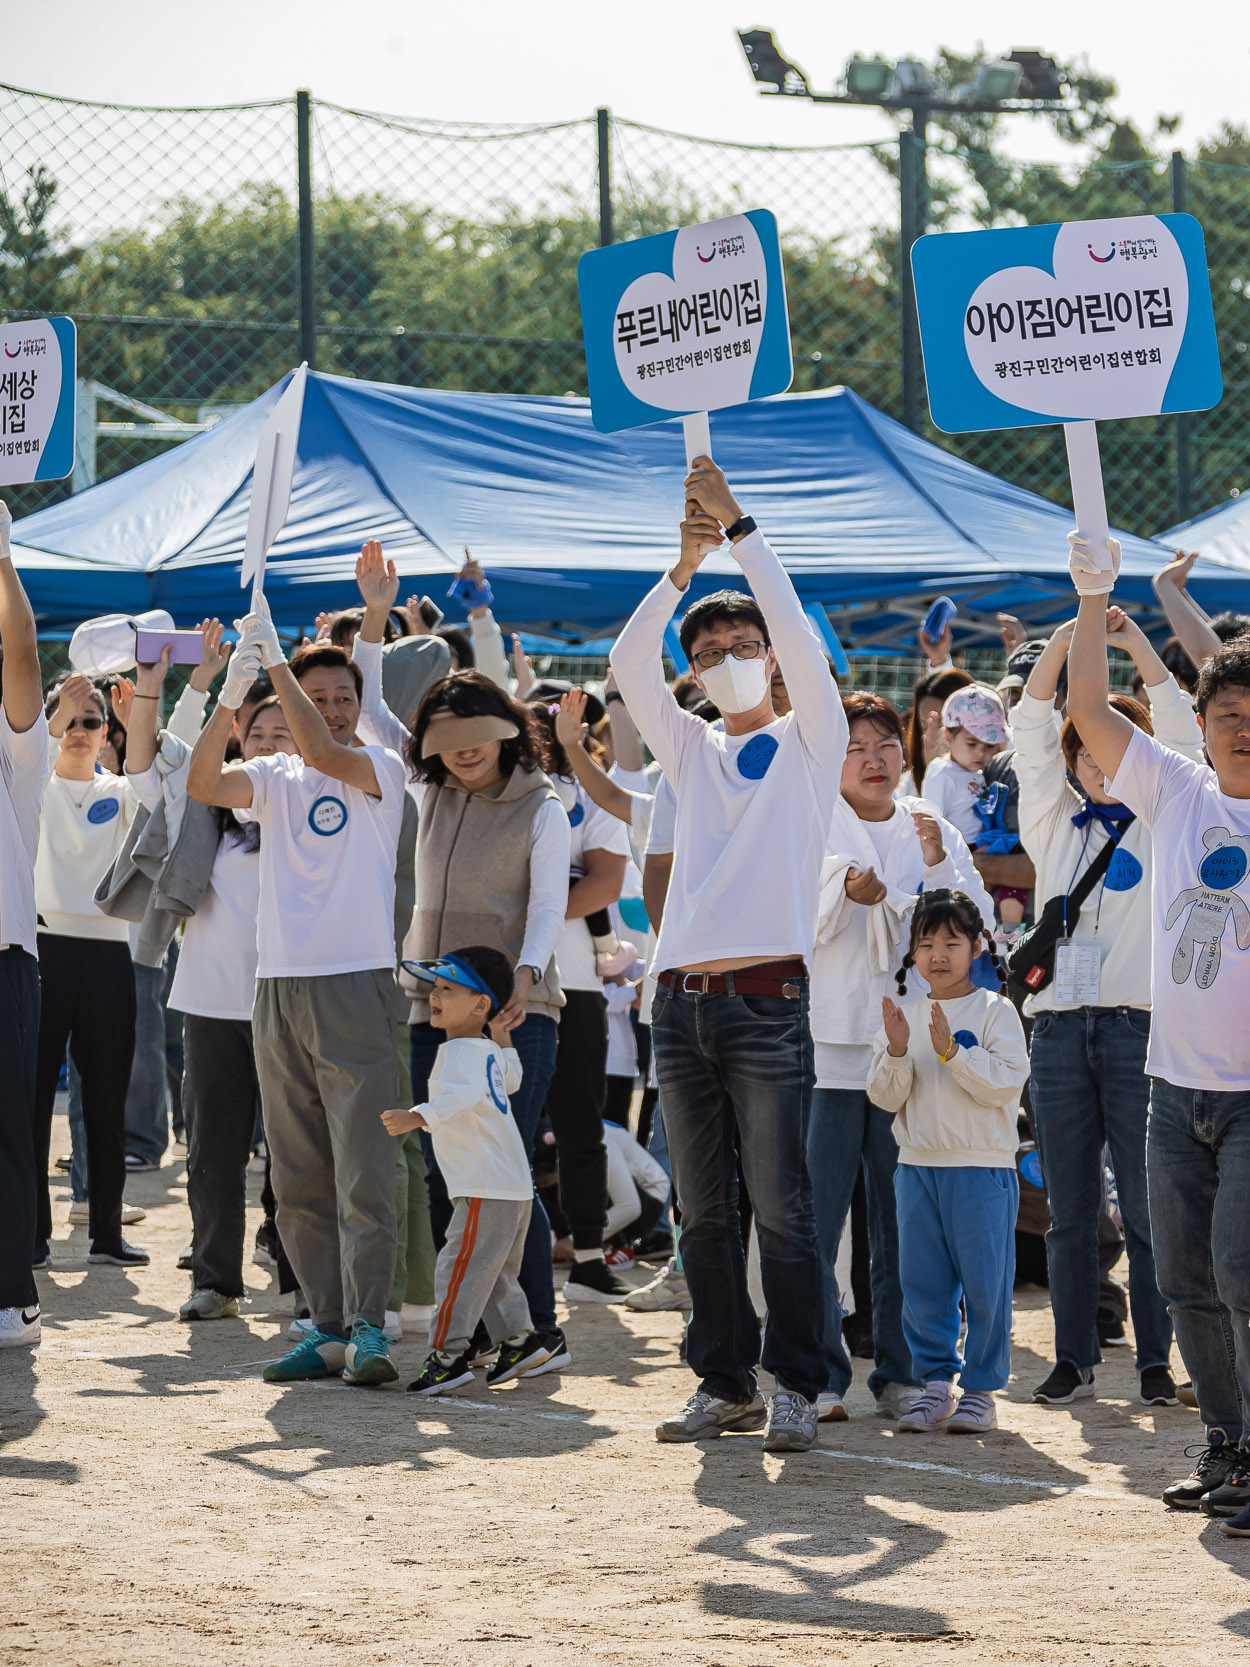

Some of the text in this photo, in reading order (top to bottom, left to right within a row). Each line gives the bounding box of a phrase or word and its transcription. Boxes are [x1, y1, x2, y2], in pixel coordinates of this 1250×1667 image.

[1119, 245, 1158, 261] 행복광진
[617, 279, 763, 354] 푸르내어린이집
[966, 287, 1174, 343] 아이짐어린이집
[636, 338, 752, 380] 광진구민간어린이집연합회
[994, 347, 1162, 379] 광진구민간어린이집연합회
